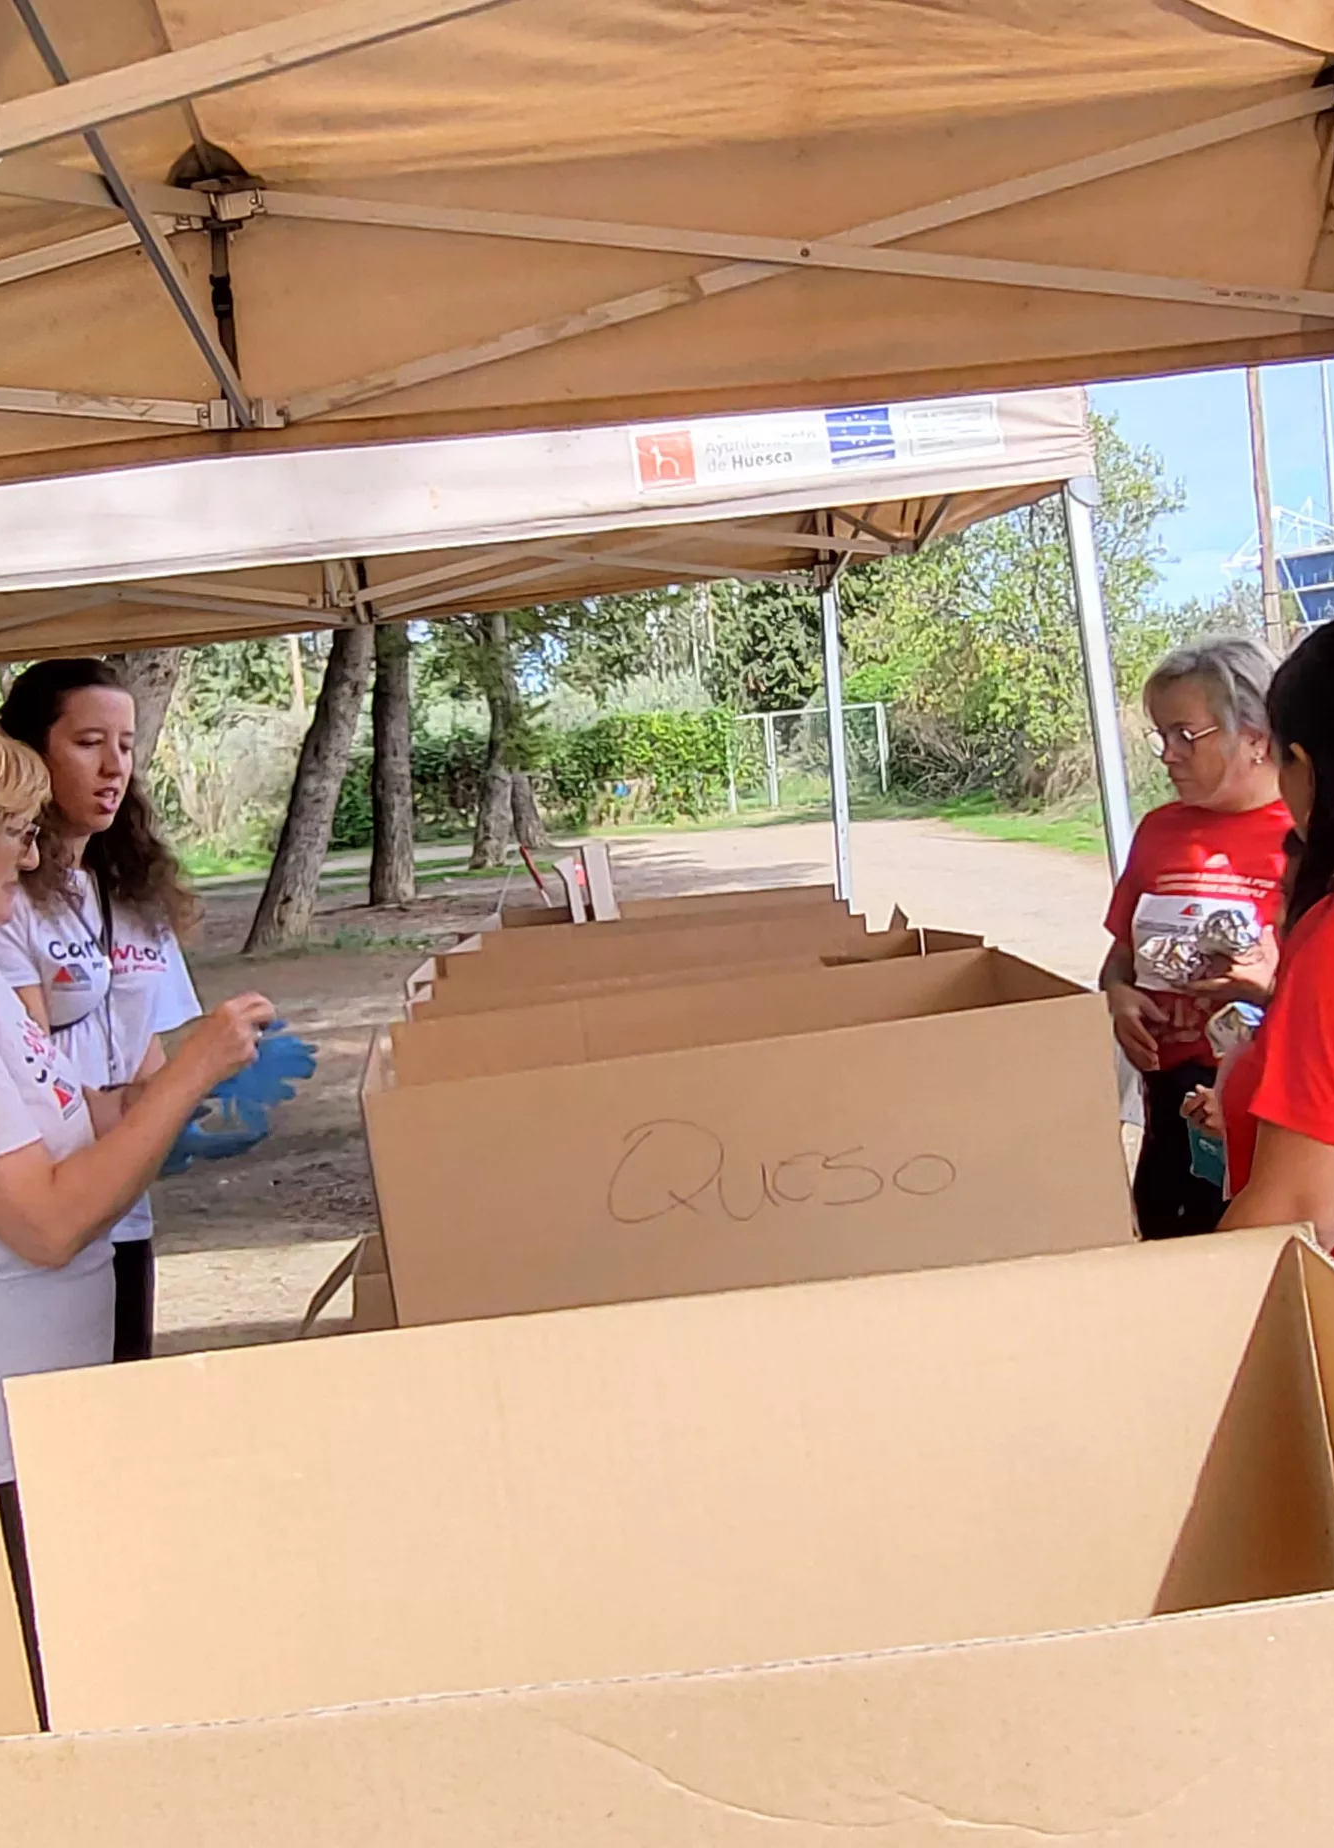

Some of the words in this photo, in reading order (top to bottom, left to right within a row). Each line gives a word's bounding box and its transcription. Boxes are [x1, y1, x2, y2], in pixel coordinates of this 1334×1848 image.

[705, 429, 817, 458] Ayuntanto
[731, 451, 792, 471] Huesca
[608, 1118, 957, 1223] Queso
